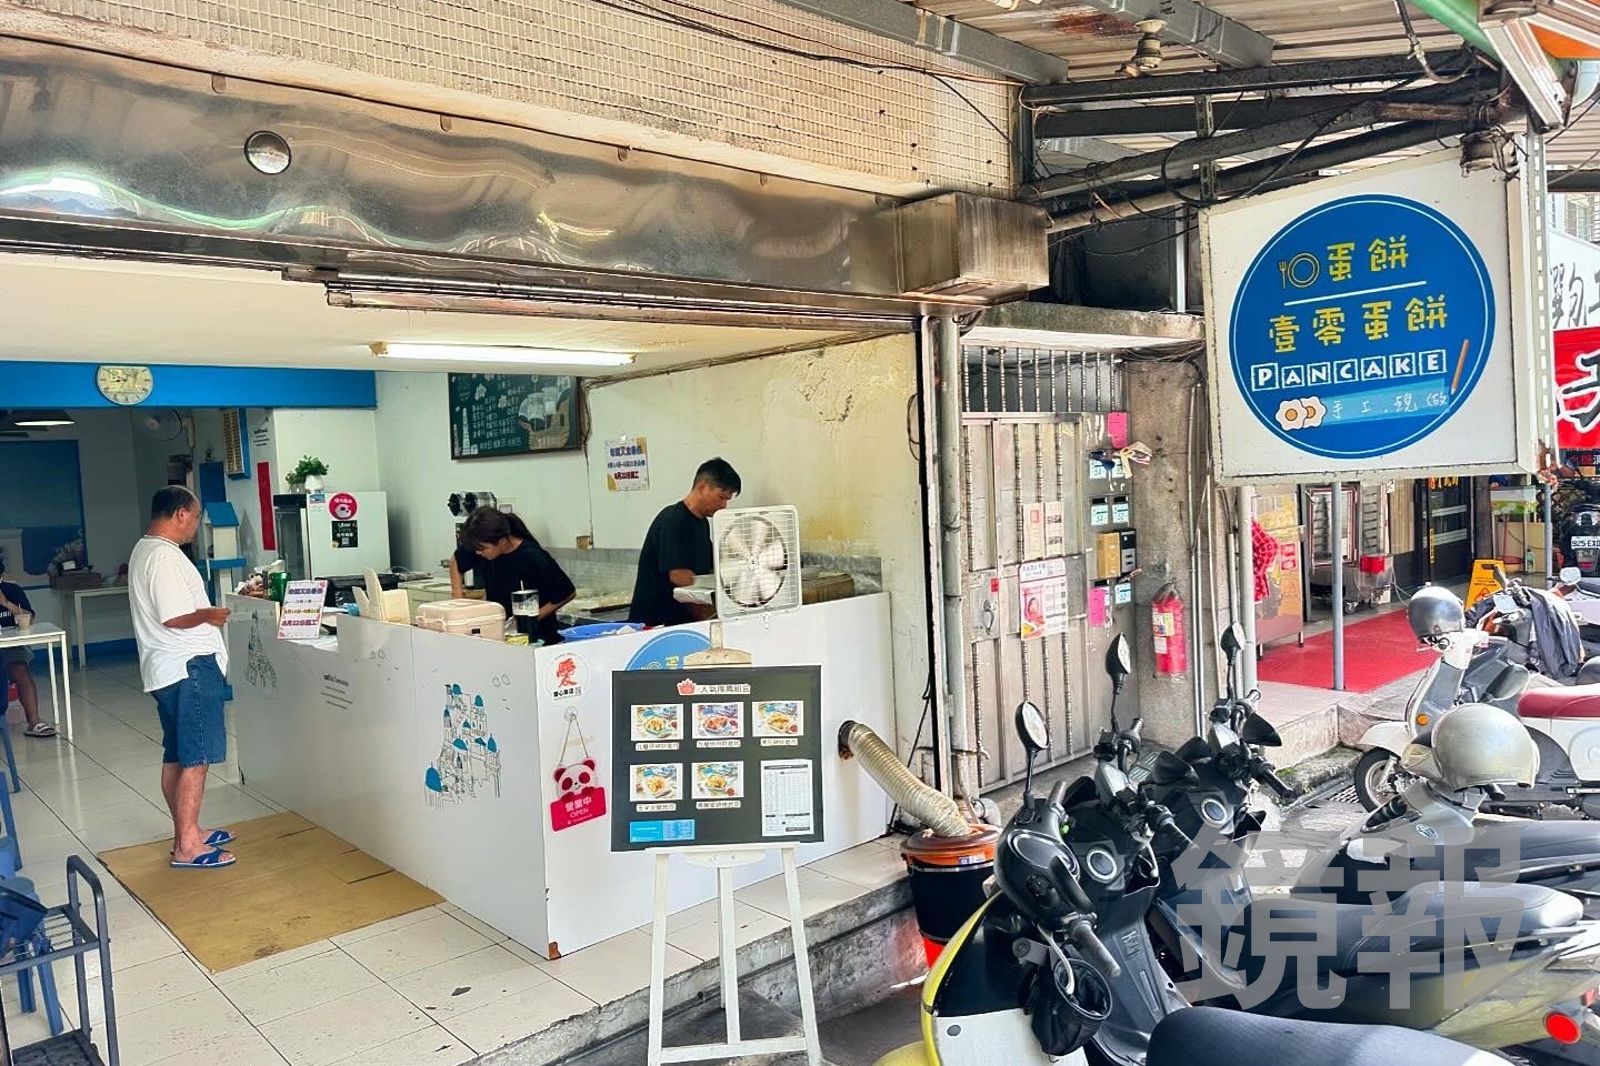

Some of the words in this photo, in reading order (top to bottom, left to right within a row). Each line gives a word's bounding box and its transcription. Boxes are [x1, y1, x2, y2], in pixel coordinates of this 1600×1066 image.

[1327, 234, 1409, 282] 蛋餅
[1269, 294, 1448, 353] 壹零蛋餅
[1254, 354, 1443, 388] PANCAKE
[565, 796, 592, 812] 營業中
[570, 807, 589, 818] OPEN
